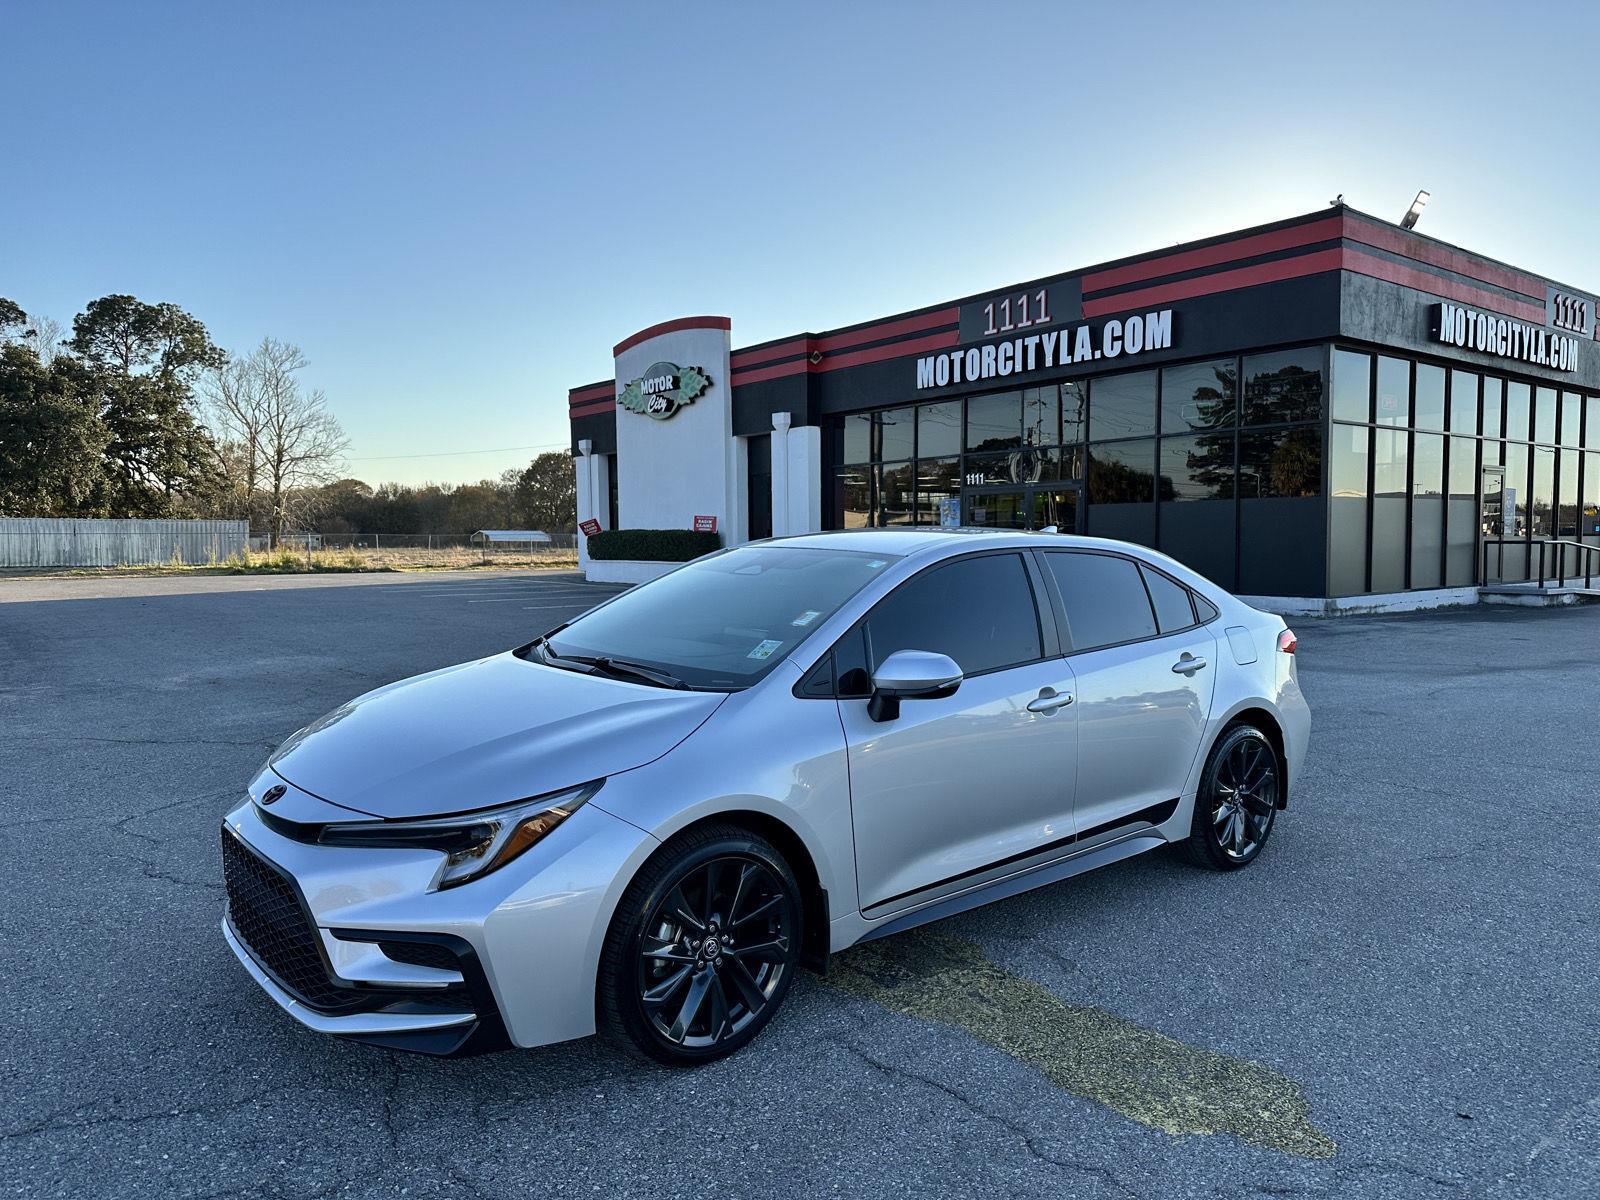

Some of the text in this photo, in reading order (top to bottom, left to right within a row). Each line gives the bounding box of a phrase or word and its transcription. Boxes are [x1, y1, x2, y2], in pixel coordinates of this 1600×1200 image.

[984, 289, 1052, 336] 1111
[1554, 294, 1588, 334] 1111
[917, 309, 1172, 389] MOTORCITYLA.COM
[1440, 303, 1579, 372] MOTORCITYLA.COM
[640, 375, 673, 395] MOTOR
[647, 394, 667, 413] City
[965, 473, 984, 485] 1111
